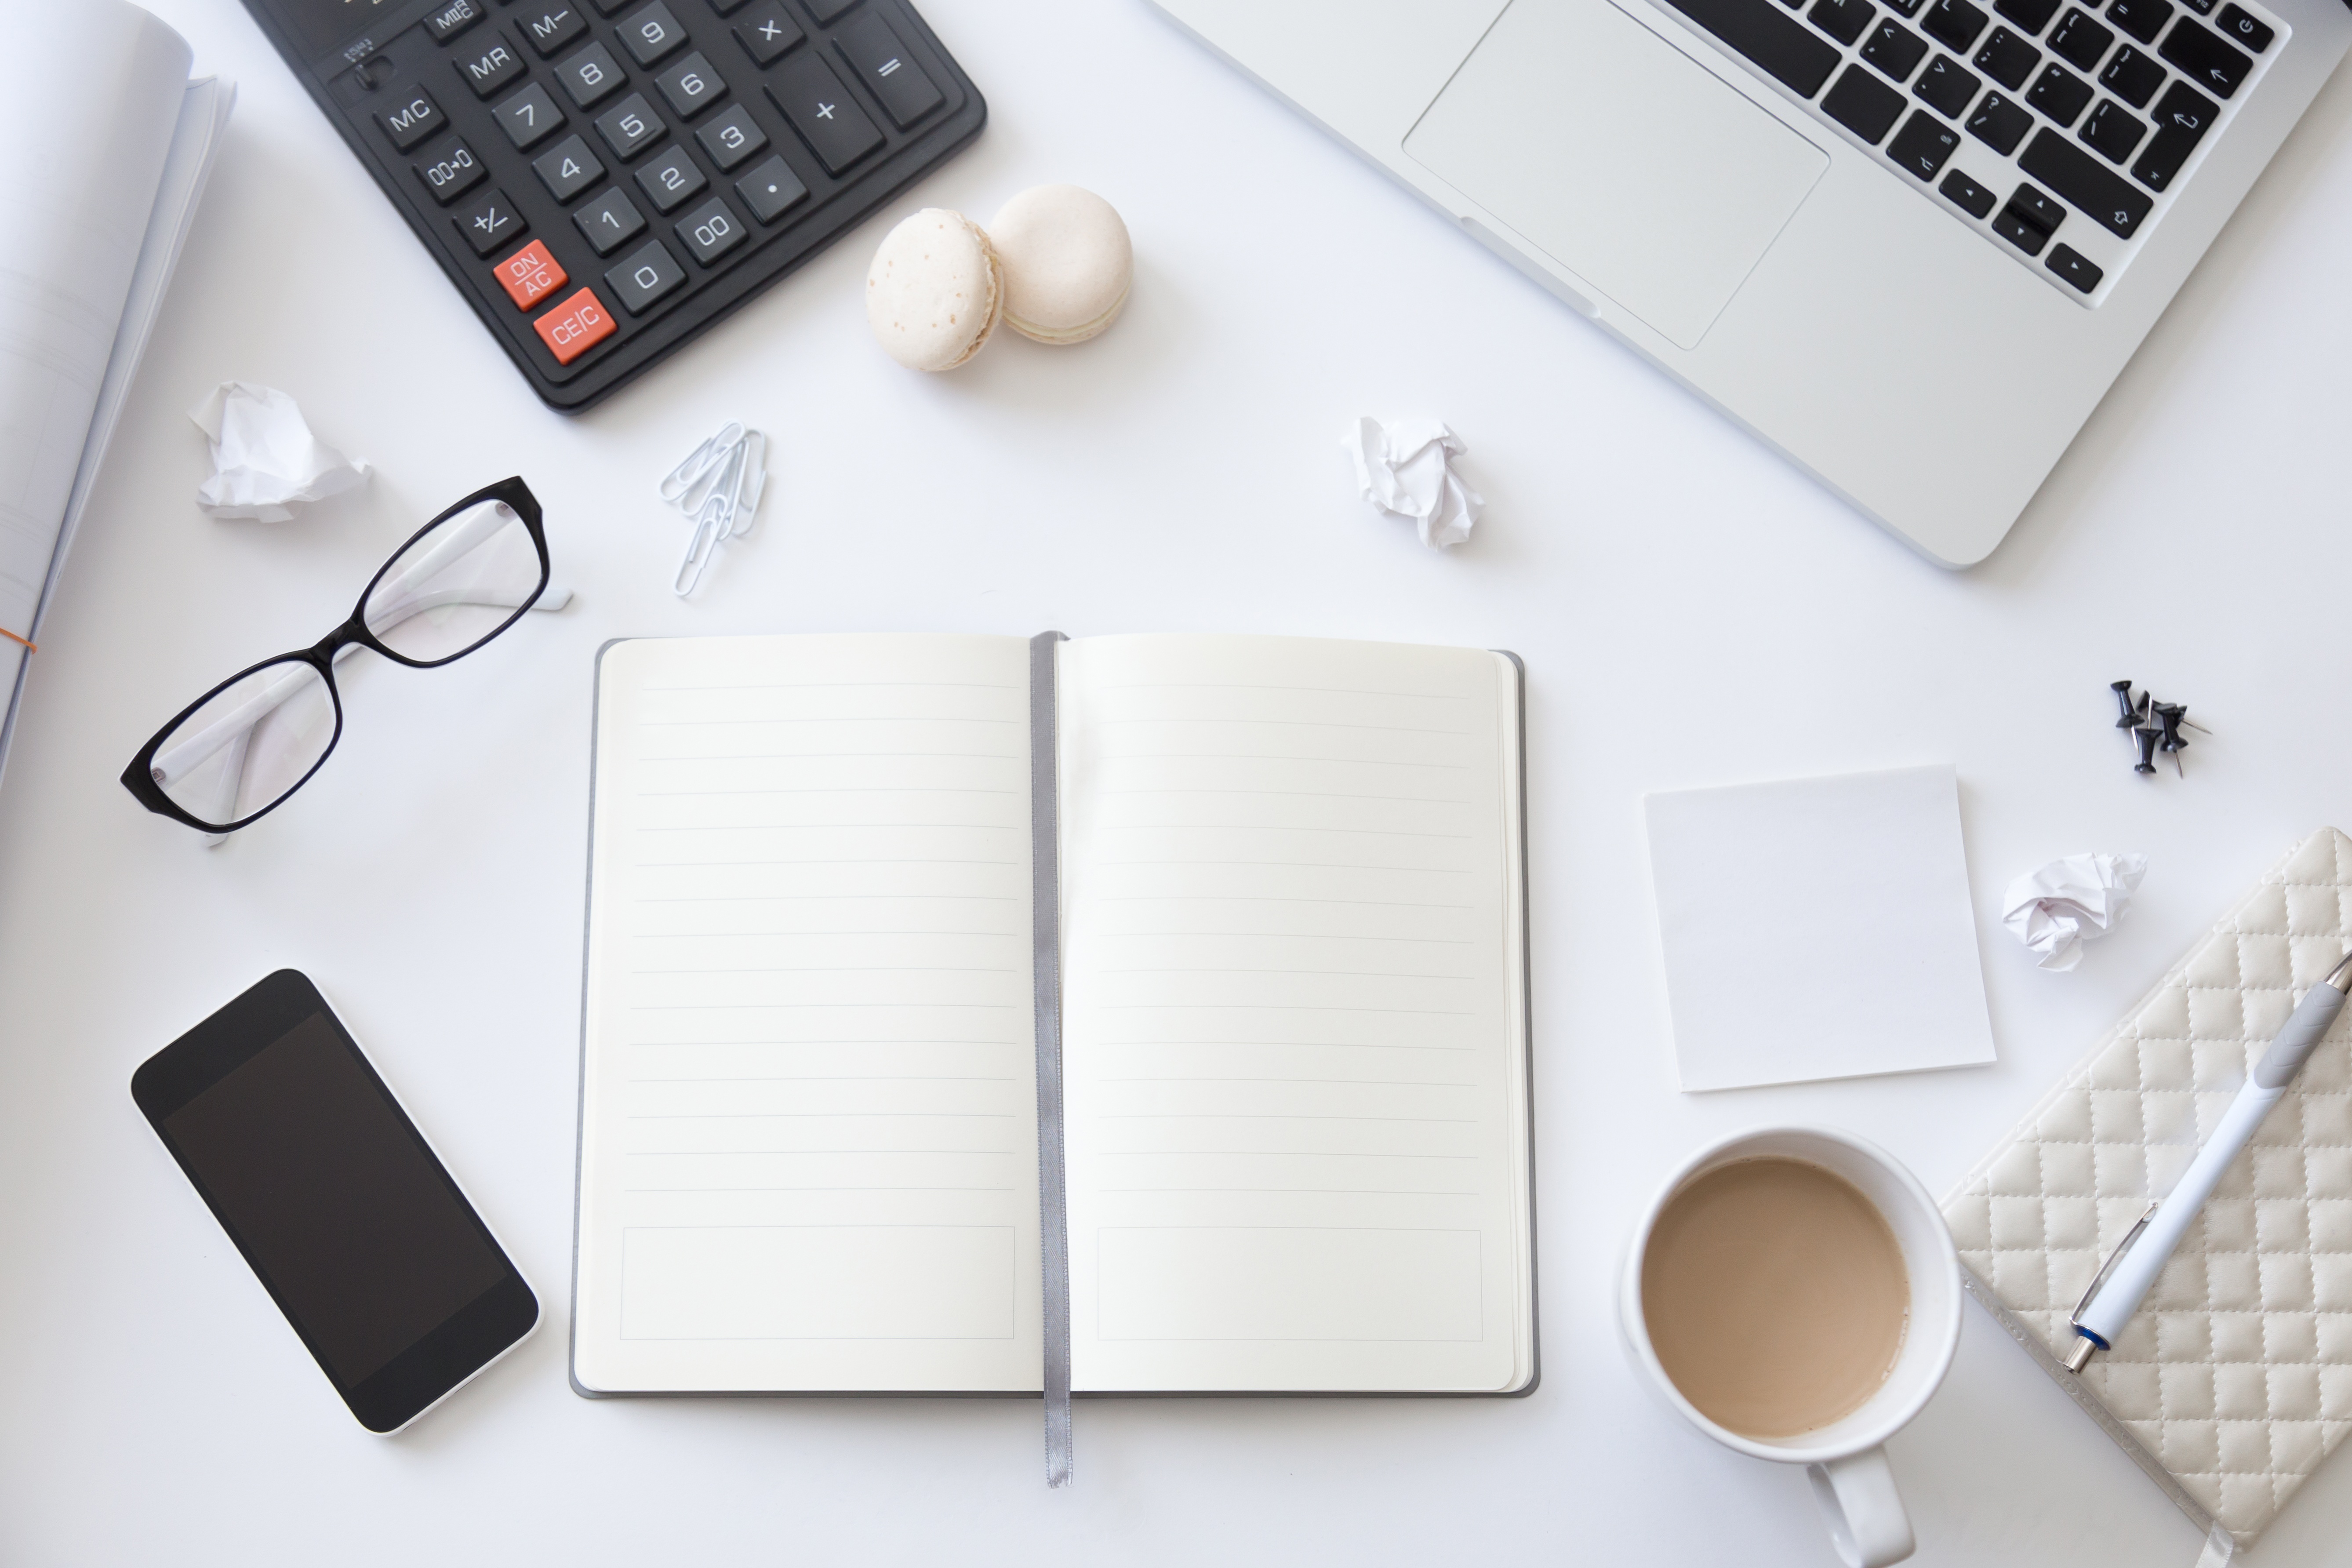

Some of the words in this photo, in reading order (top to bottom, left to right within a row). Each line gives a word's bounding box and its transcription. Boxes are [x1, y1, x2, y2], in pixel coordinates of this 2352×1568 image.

[641, 22, 665, 44] 9
[469, 47, 510, 79] MR
[579, 63, 603, 85] 8
[680, 73, 704, 95] 6
[1989, 97, 1999, 109] ?
[389, 99, 430, 131] MC
[516, 104, 534, 126] 7
[619, 114, 644, 137] 5
[720, 126, 745, 149] 3
[561, 158, 580, 178] 4
[660, 167, 685, 190] 2
[474, 207, 508, 233] +/-
[601, 210, 621, 229] 1
[694, 215, 730, 246] 00
[510, 252, 540, 279] ON
[524, 269, 553, 297] AC
[634, 266, 658, 289] 0
[552, 306, 600, 345] CE/C
